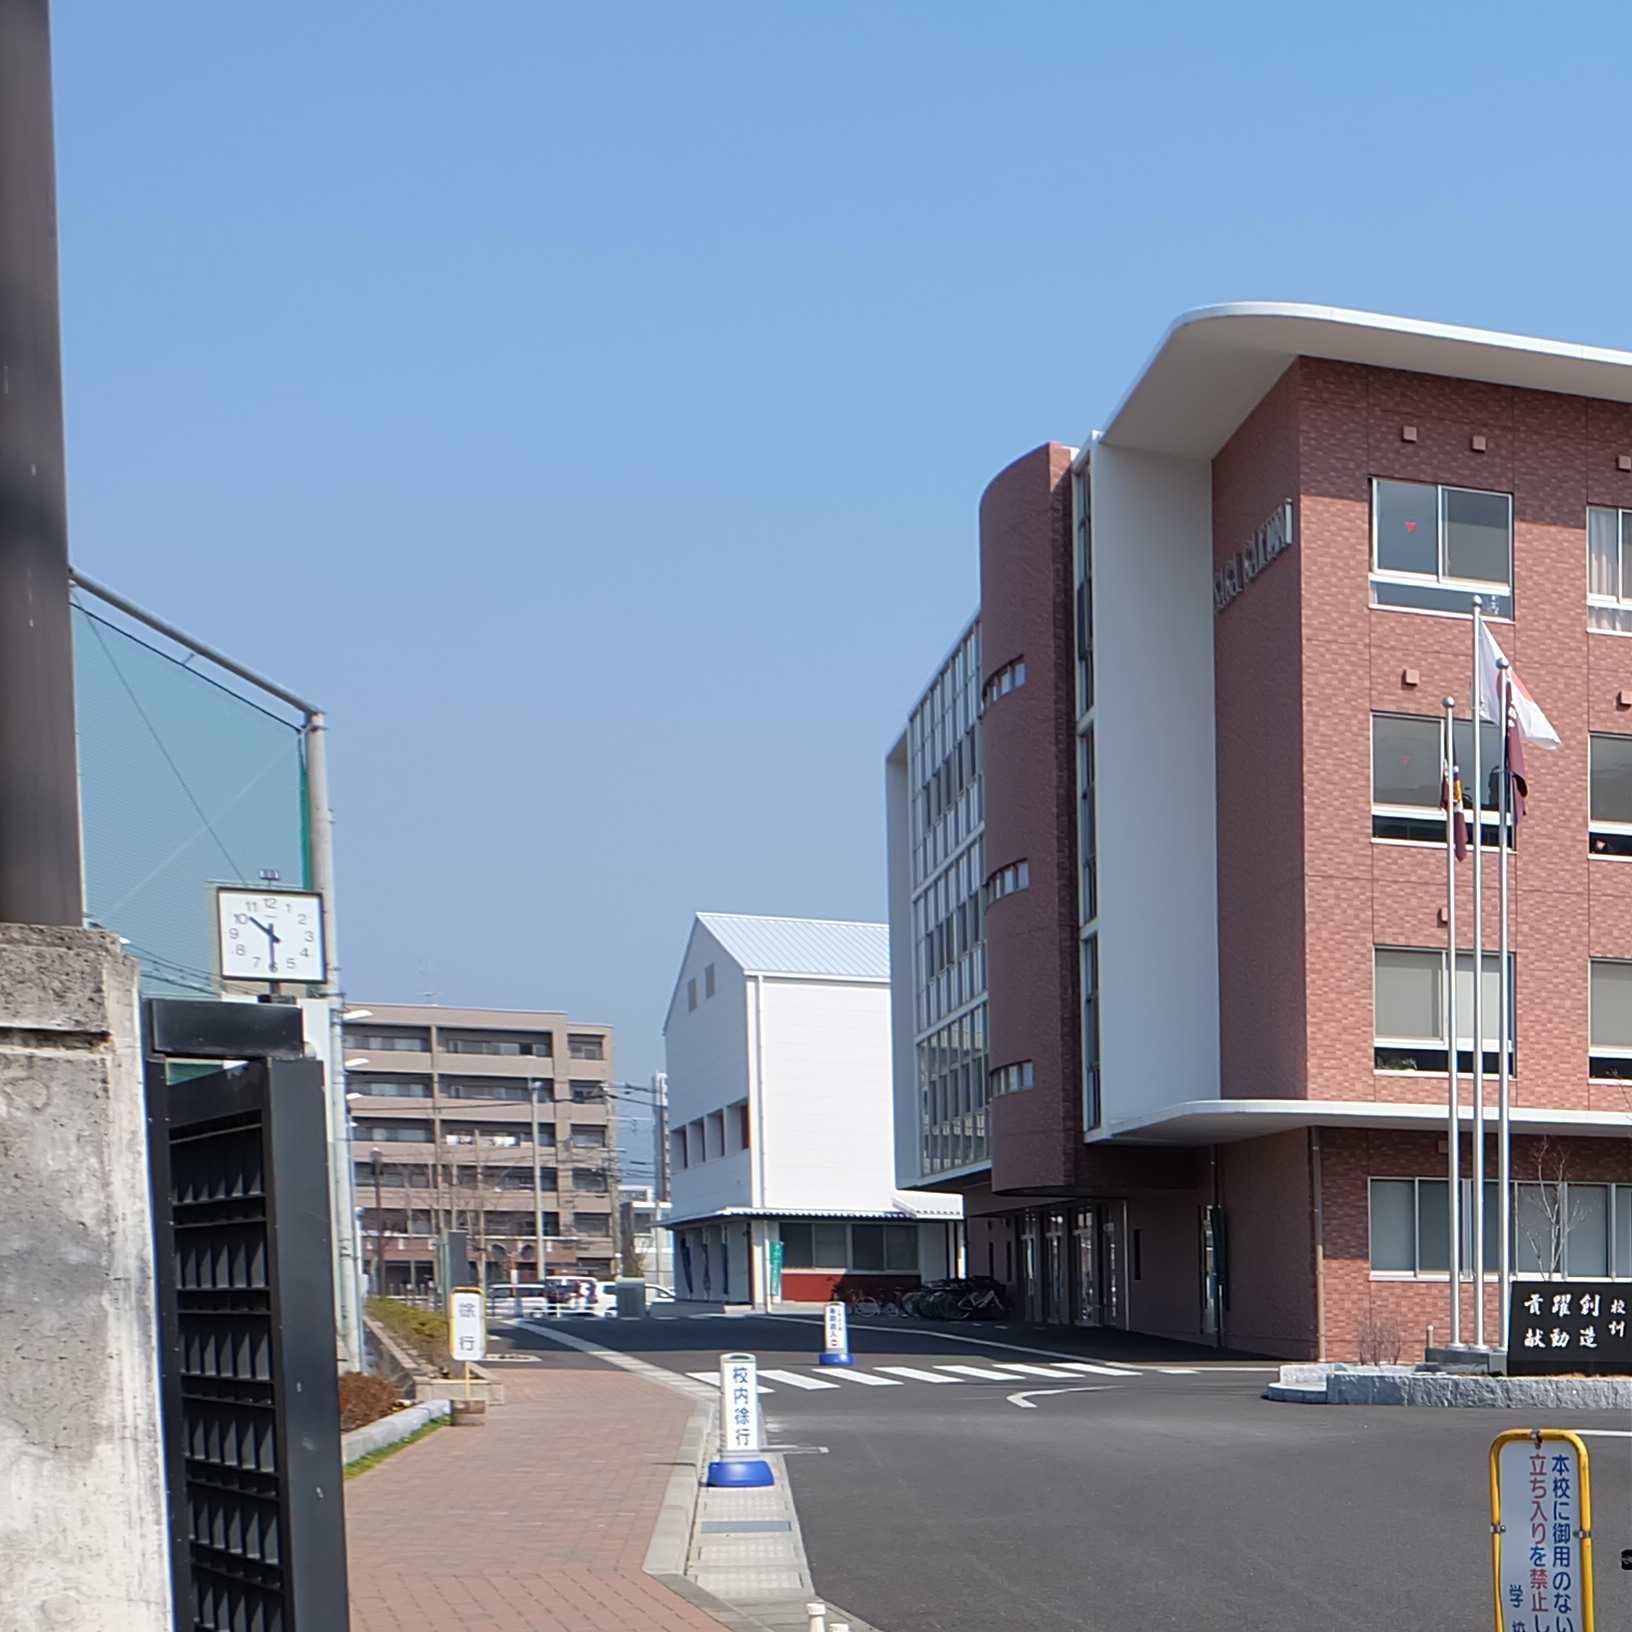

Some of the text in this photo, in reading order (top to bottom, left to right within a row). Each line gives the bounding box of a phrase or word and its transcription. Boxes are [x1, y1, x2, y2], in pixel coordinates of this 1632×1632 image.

[245, 901, 258, 912] 11
[263, 897, 277, 909] 12
[285, 903, 292, 913] 1
[233, 913, 249, 925] 10
[298, 913, 307, 925] 2
[229, 928, 239, 940] 9
[304, 930, 314, 943] 3
[236, 944, 246, 956] 8
[300, 948, 309, 958] 4
[252, 956, 261, 967] 7
[286, 958, 296, 969] 5
[1550, 1293, 1572, 1348] 躍動
[1579, 1293, 1601, 1348] 創造
[1608, 1299, 1627, 1338] 校訓
[460, 1303, 475, 1351] 徐行
[733, 1366, 751, 1446] 校内徐行
